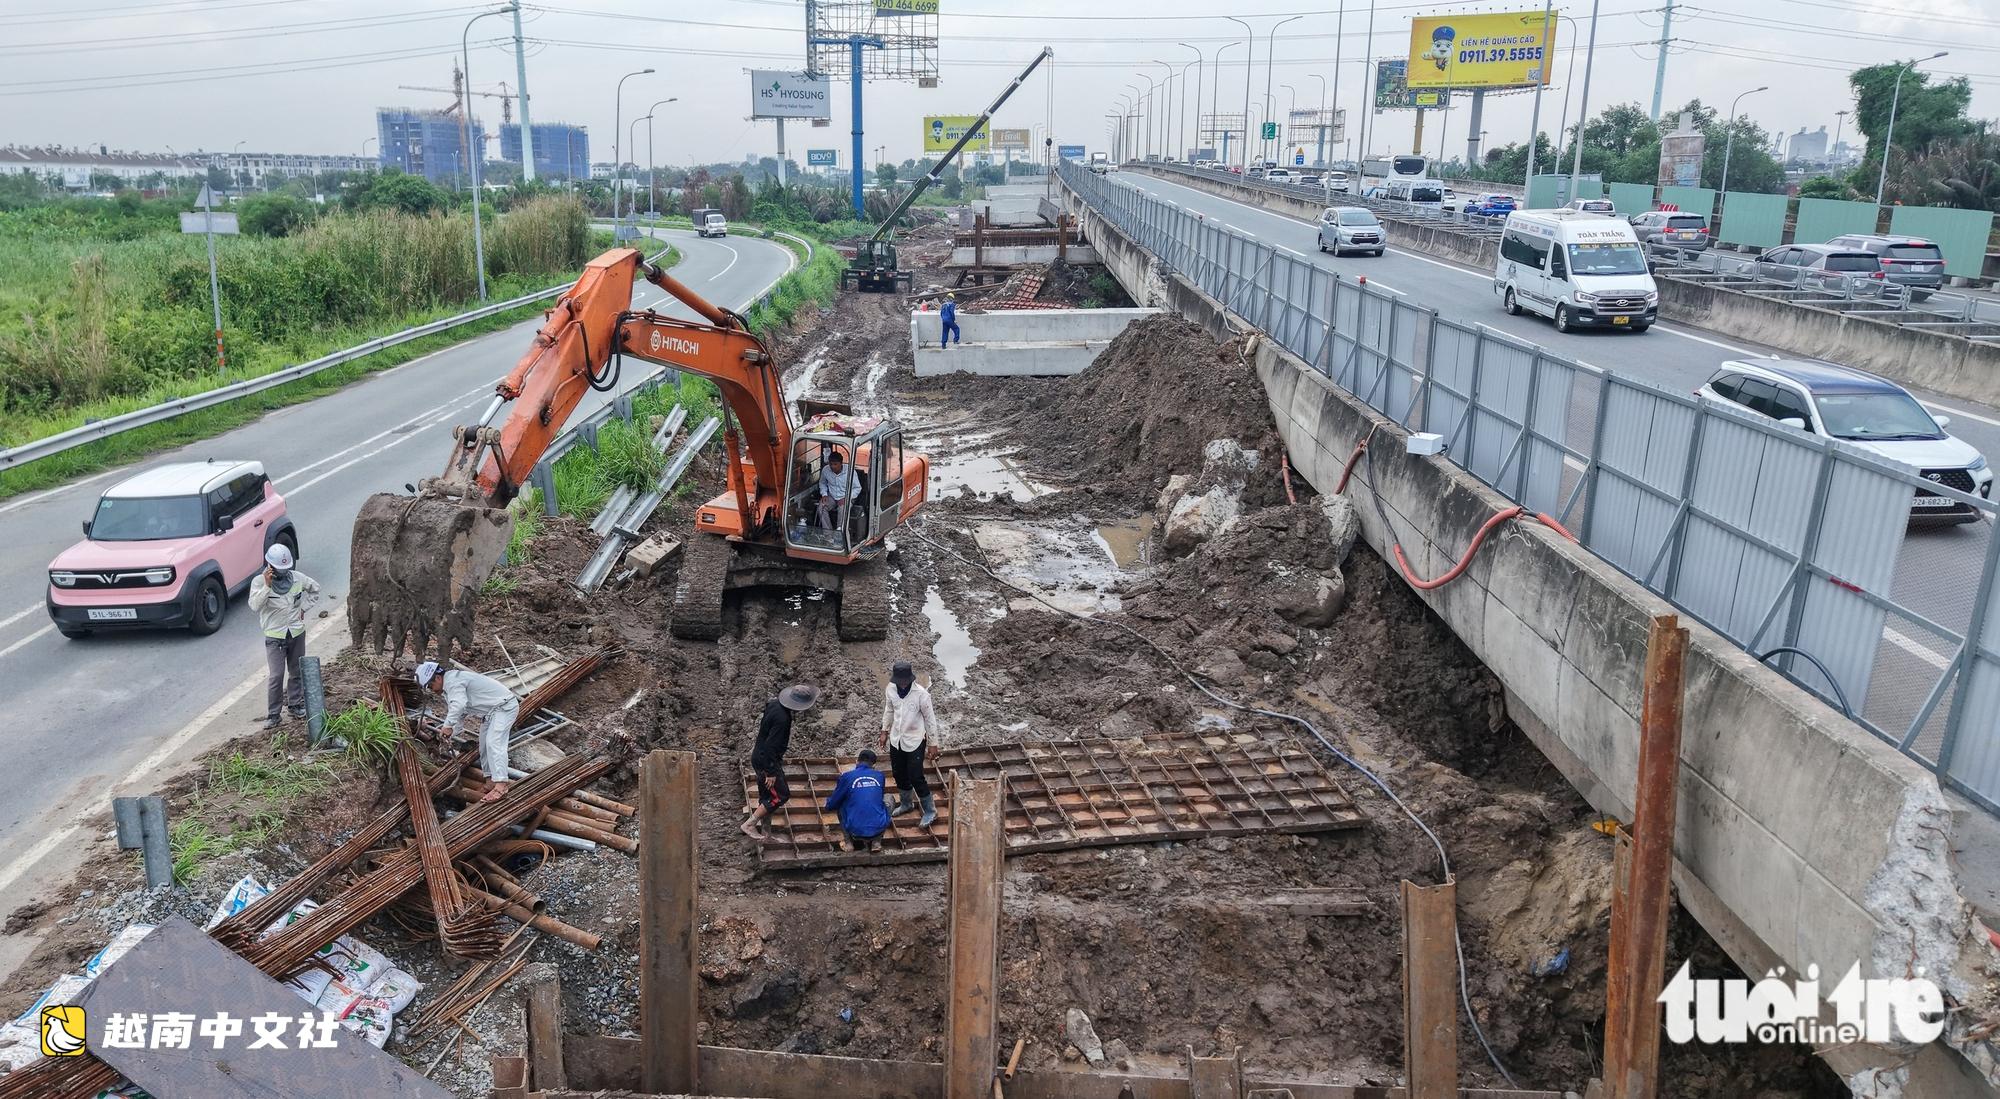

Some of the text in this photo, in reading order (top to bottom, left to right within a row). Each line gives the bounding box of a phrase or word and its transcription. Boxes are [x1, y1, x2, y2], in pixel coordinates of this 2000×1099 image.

[896, 0, 912, 9] 464
[915, 1, 937, 11] 6699
[1459, 47, 1542, 63] 0911.39.5555
[761, 89, 824, 100] HS HYOSUNG
[1377, 95, 1410, 105] PALM
[662, 335, 699, 356] HITACHI
